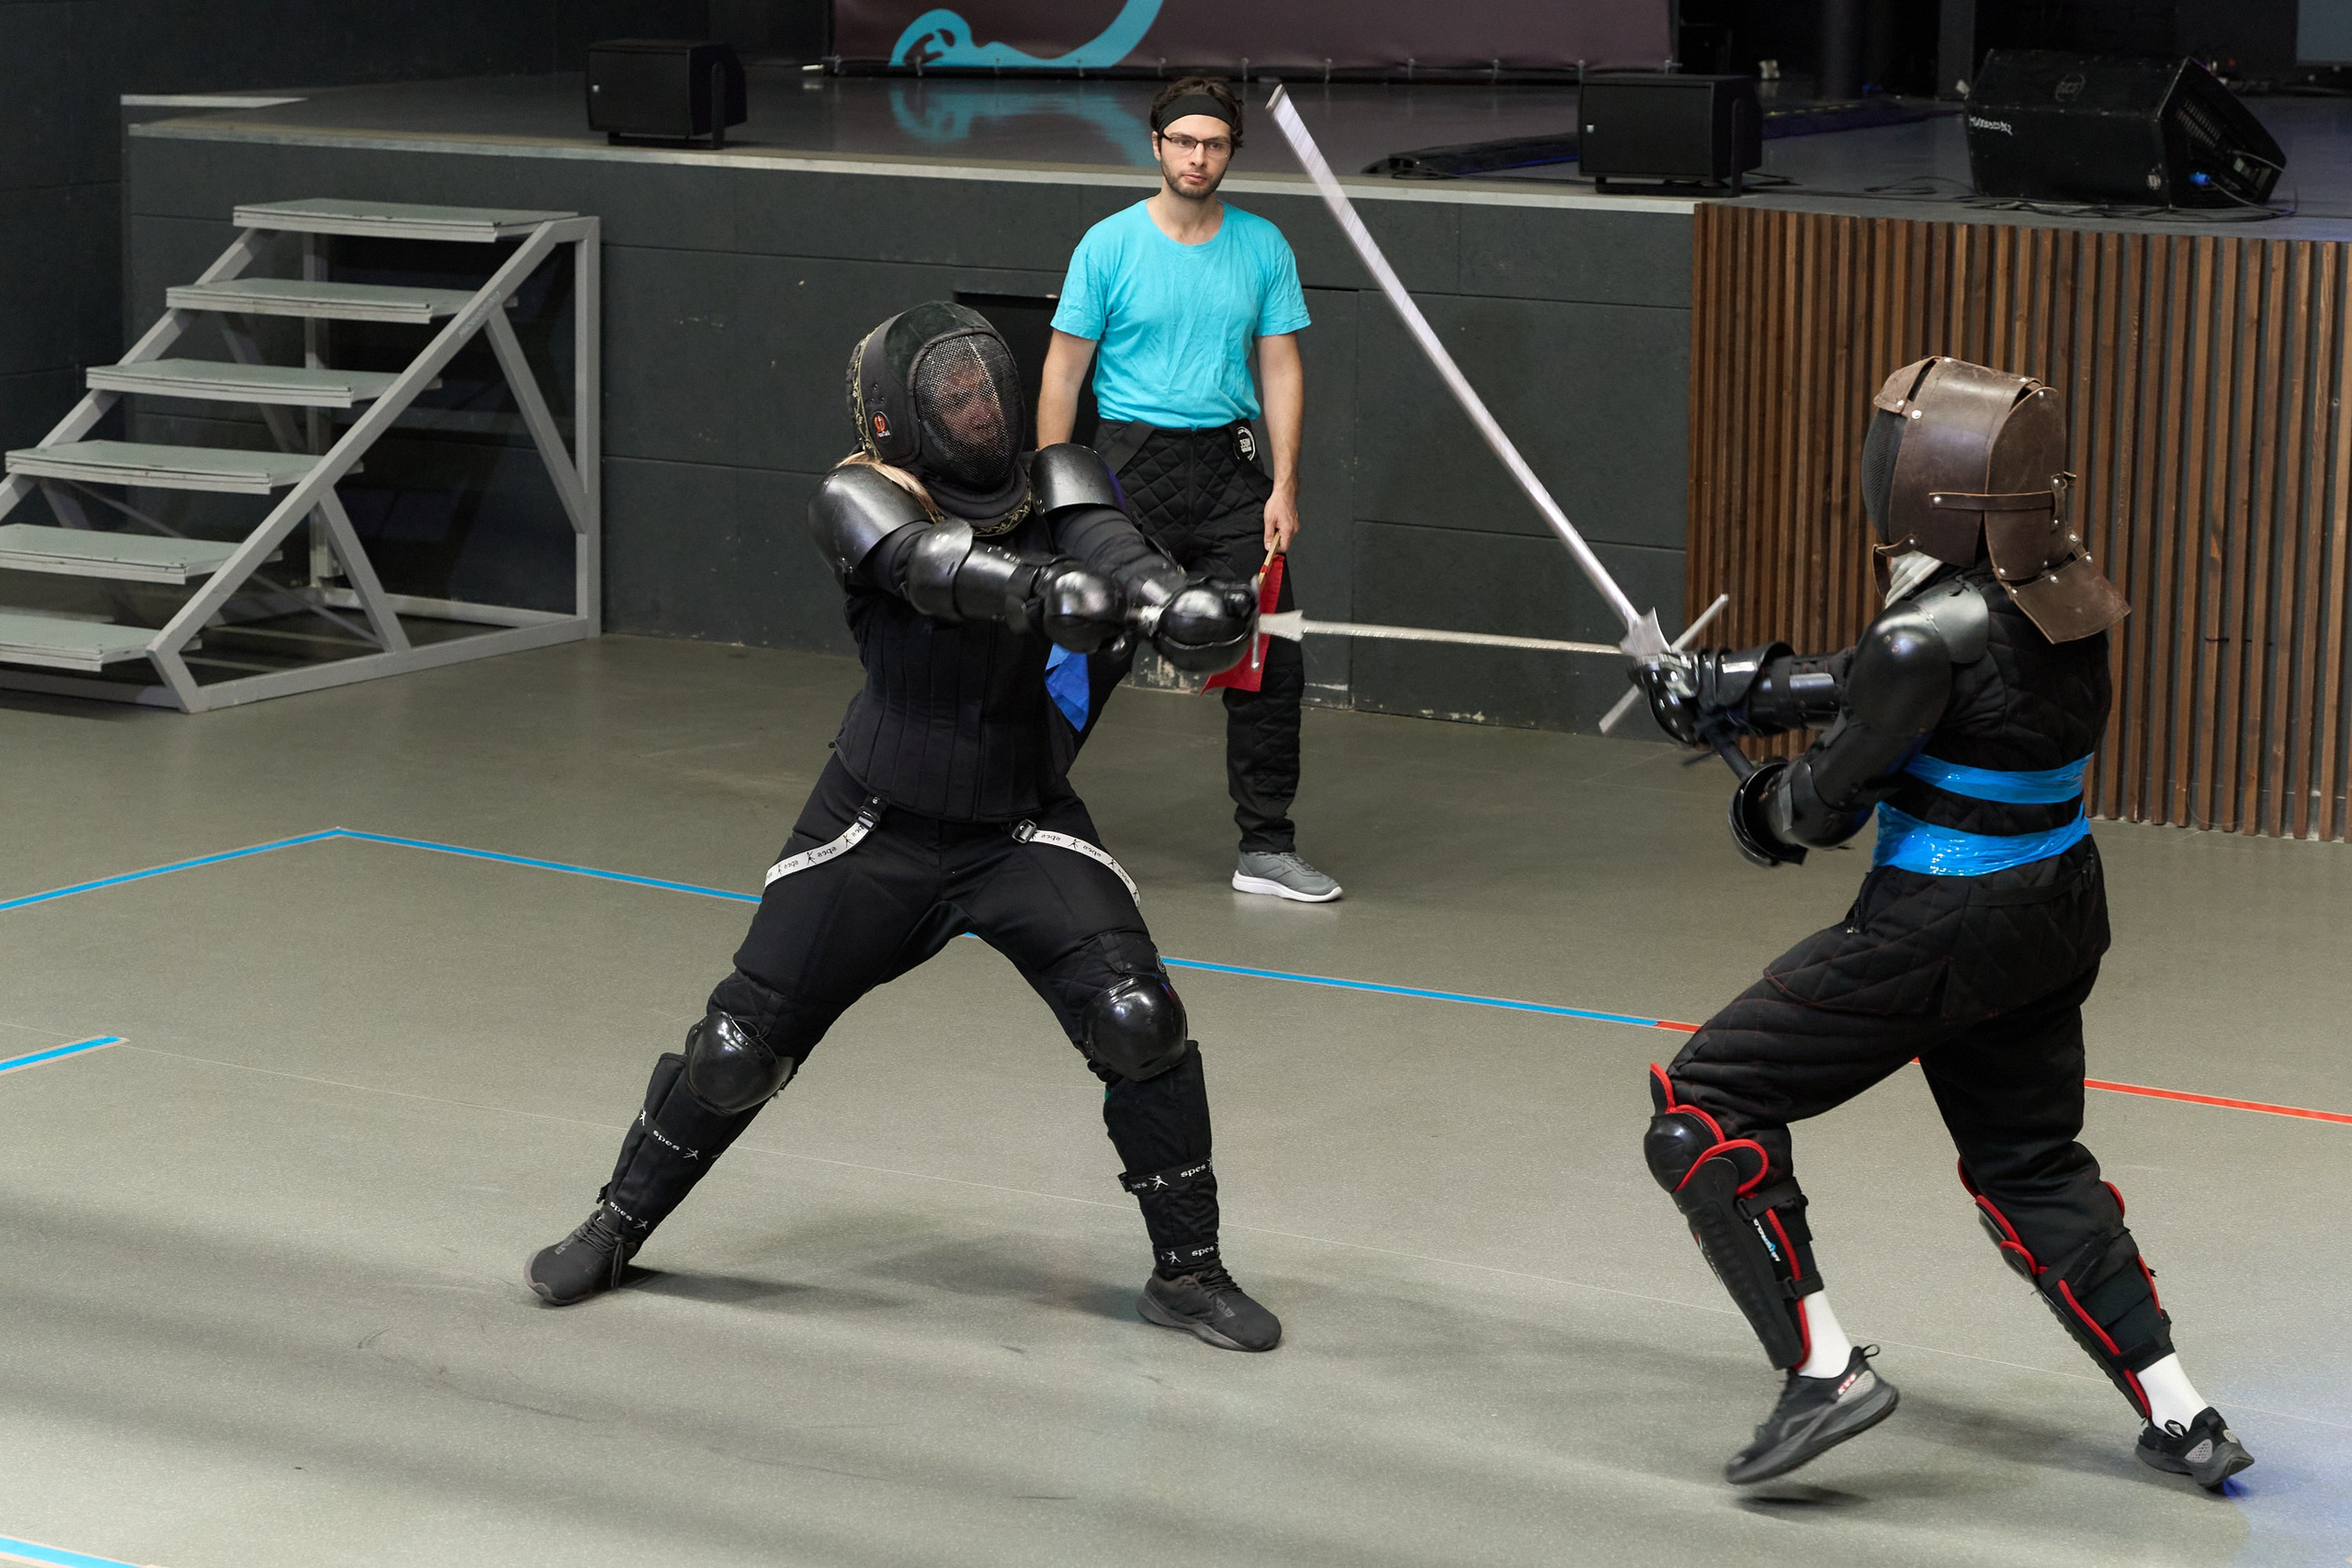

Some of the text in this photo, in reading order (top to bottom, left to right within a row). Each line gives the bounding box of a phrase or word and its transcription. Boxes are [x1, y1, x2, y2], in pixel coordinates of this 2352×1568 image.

[653, 1130, 680, 1151] spes
[1181, 1164, 1206, 1178] spes
[1192, 1246, 1215, 1257] spes
